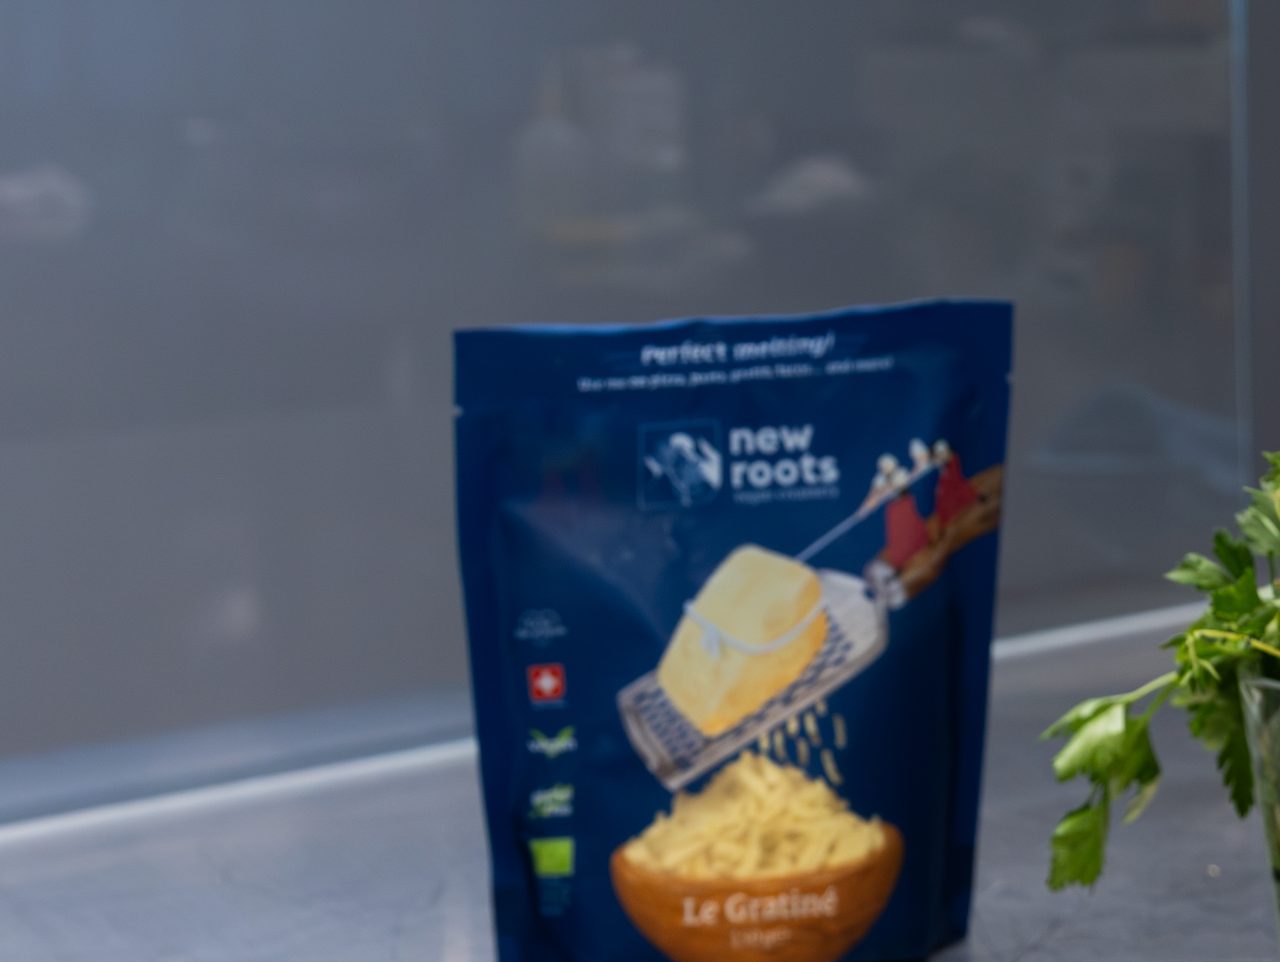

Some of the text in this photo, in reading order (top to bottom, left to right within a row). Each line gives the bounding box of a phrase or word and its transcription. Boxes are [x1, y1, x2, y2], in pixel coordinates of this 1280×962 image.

[640, 340, 727, 367] Perfect
[729, 424, 814, 456] new
[730, 452, 840, 489] roots
[682, 885, 839, 928] Le Gratiné
